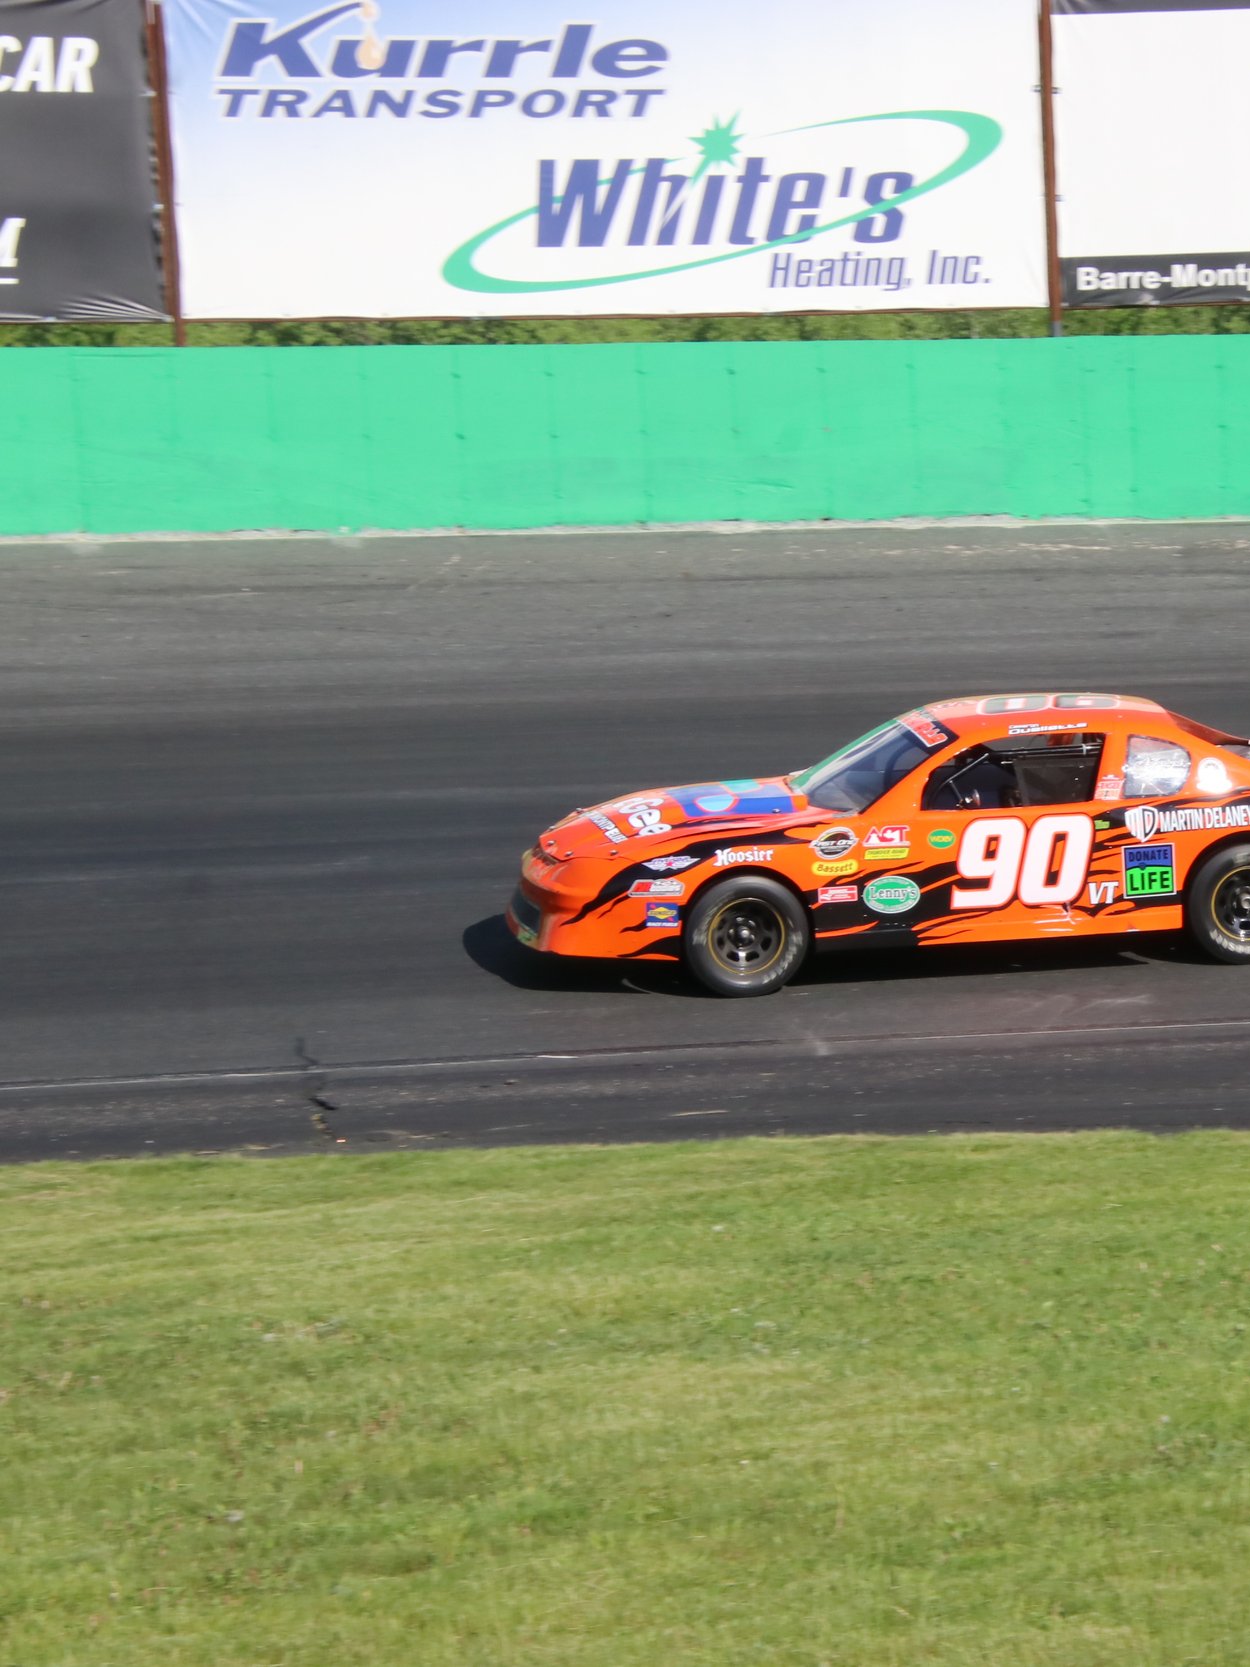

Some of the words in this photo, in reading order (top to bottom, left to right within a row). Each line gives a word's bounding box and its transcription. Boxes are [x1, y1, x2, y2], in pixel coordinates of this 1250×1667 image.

[219, 2, 669, 79] Kurrle
[217, 88, 665, 119] TRANSPORT
[536, 156, 915, 247] White's
[768, 251, 912, 291] Heating,
[926, 250, 992, 285] Inc.
[1159, 808, 1204, 832] MARTIN
[712, 847, 775, 867] Hoosier
[951, 813, 1096, 911] 90
[1128, 848, 1170, 863] DONATE
[868, 885, 917, 902] Lenny's
[1088, 880, 1119, 905] VT
[1129, 870, 1170, 892] LIFE
